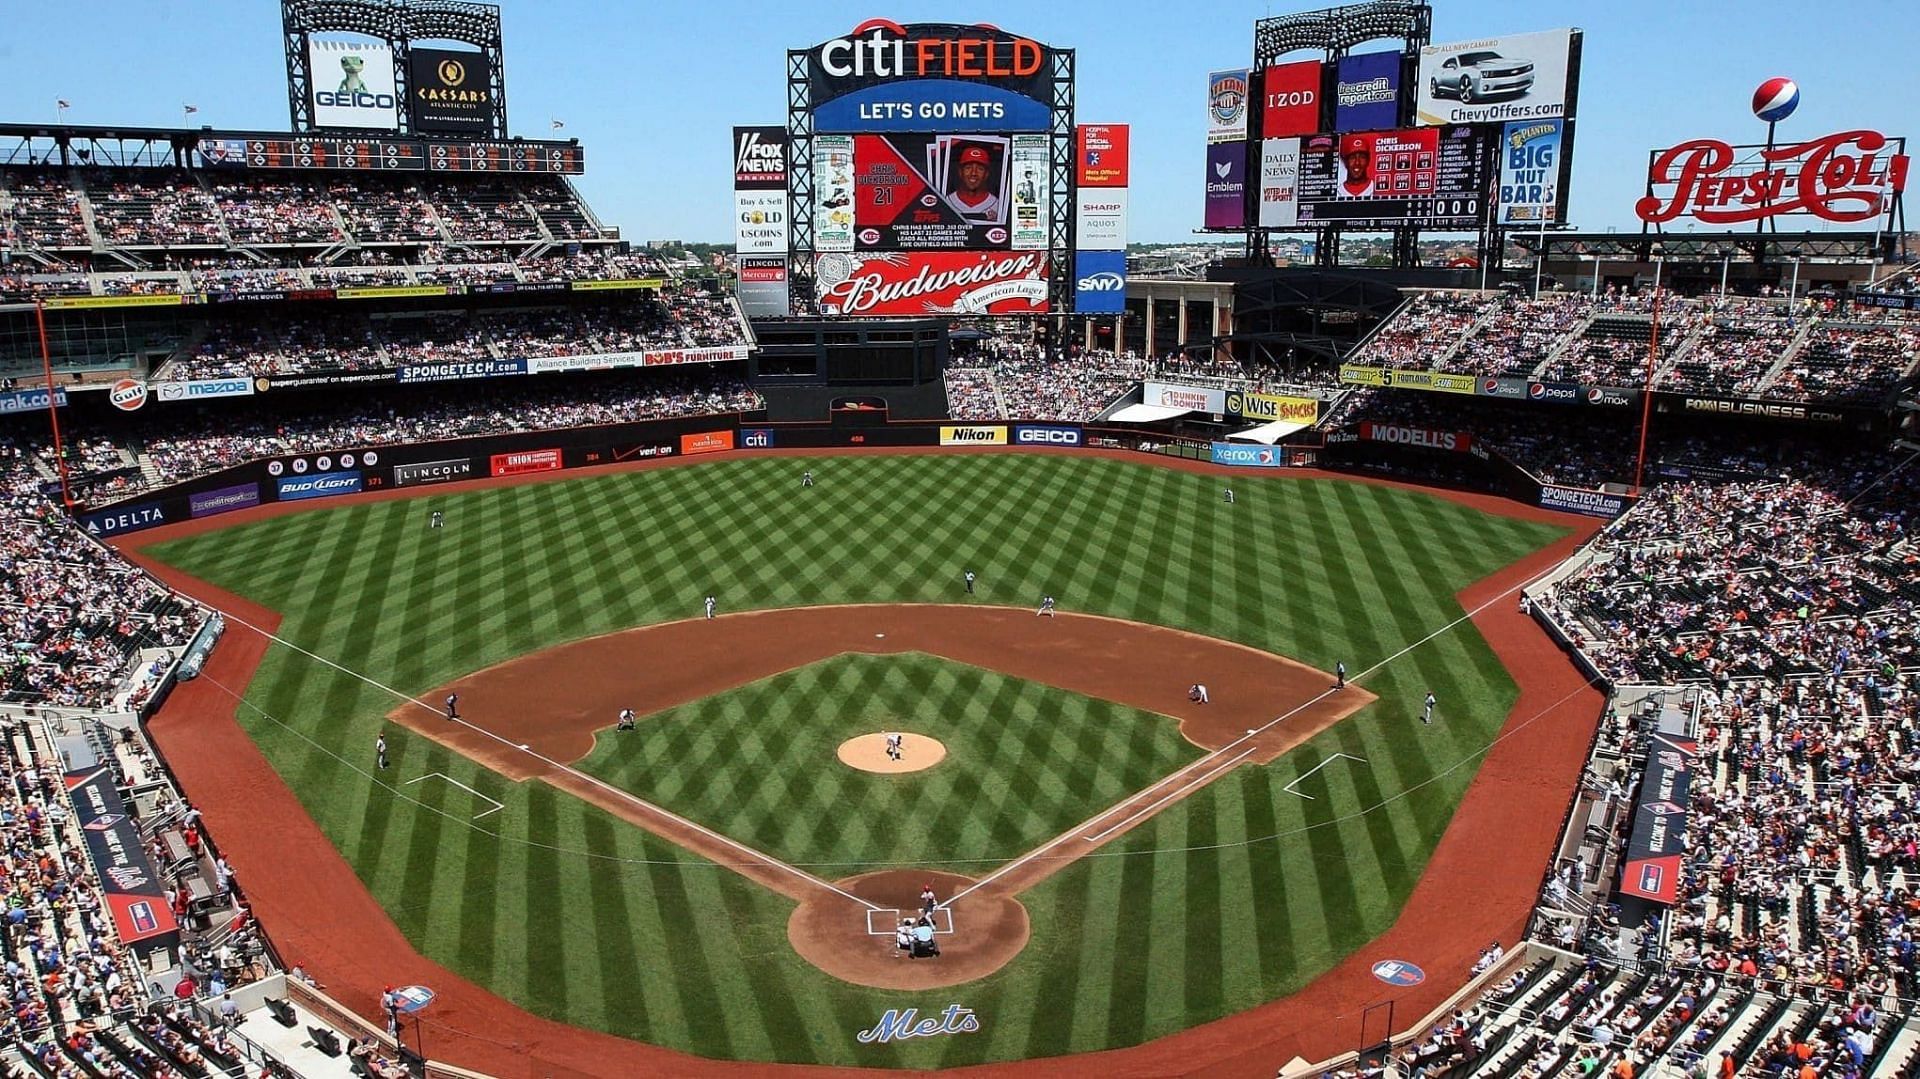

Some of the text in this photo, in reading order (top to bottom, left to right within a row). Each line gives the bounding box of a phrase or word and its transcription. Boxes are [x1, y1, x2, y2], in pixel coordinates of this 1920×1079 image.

[821, 28, 1042, 76] citi FIELD
[1339, 79, 1388, 94] freecredit
[315, 91, 394, 109] GEICO
[418, 88, 487, 102] CAESARS
[1269, 91, 1314, 107] IZOD
[1340, 91, 1394, 105] report.com
[860, 102, 1003, 119] LET'S GO METS
[1451, 103, 1563, 121] ChevyOffers.com
[1521, 124, 1555, 139] PLANTERS
[751, 144, 783, 158] FOX
[1376, 143, 1421, 152] DICKERSON
[1265, 154, 1295, 163] DAILY
[1509, 144, 1553, 169] BIG
[743, 159, 784, 173] NEWS
[871, 164, 896, 173] CHRIS
[1264, 168, 1295, 176] NEWS
[1515, 170, 1545, 184] NUT
[1207, 182, 1242, 192] Emblem
[874, 187, 893, 204] 21
[741, 199, 757, 207] Buy
[1437, 200, 1476, 214] 0 0 0
[741, 230, 782, 238] USCOINS
[748, 259, 783, 267] LINCOLN
[742, 271, 773, 280] Mercury
[831, 254, 1035, 313] Budweiser
[1077, 277, 1120, 292] SNY
[972, 286, 1044, 307] American Lager
[537, 355, 635, 369] Alliance Building Services
[645, 351, 734, 365] BOB'S FURNITURE
[404, 362, 517, 378] SPONGETECH.com
[1343, 370, 1377, 381] SUBWAY
[1379, 370, 1392, 385] $5
[1434, 378, 1473, 389] SUBWAY
[114, 387, 142, 402] Gulf
[188, 380, 247, 395] mazda
[1546, 388, 1576, 398] pepsi
[1173, 392, 1207, 401] DUNKIN'
[1604, 396, 1628, 406] max
[1173, 399, 1206, 410] DONUTS
[1246, 397, 1316, 418] WISE SNACKS
[745, 434, 767, 447] citi
[952, 428, 995, 441] Nikon
[1019, 429, 1078, 443] GEICO
[1371, 424, 1456, 450] MODELL'S
[640, 446, 672, 456] verizon
[1216, 449, 1256, 461] xerox
[271, 464, 280, 472] 37
[343, 457, 352, 465] 42
[404, 464, 470, 479] LINCOLN
[281, 478, 358, 492] BUD LIGHT
[1542, 487, 1620, 508] SPONGETECH.com
[105, 508, 163, 530] DELTA
[857, 1004, 979, 1043] Mets
